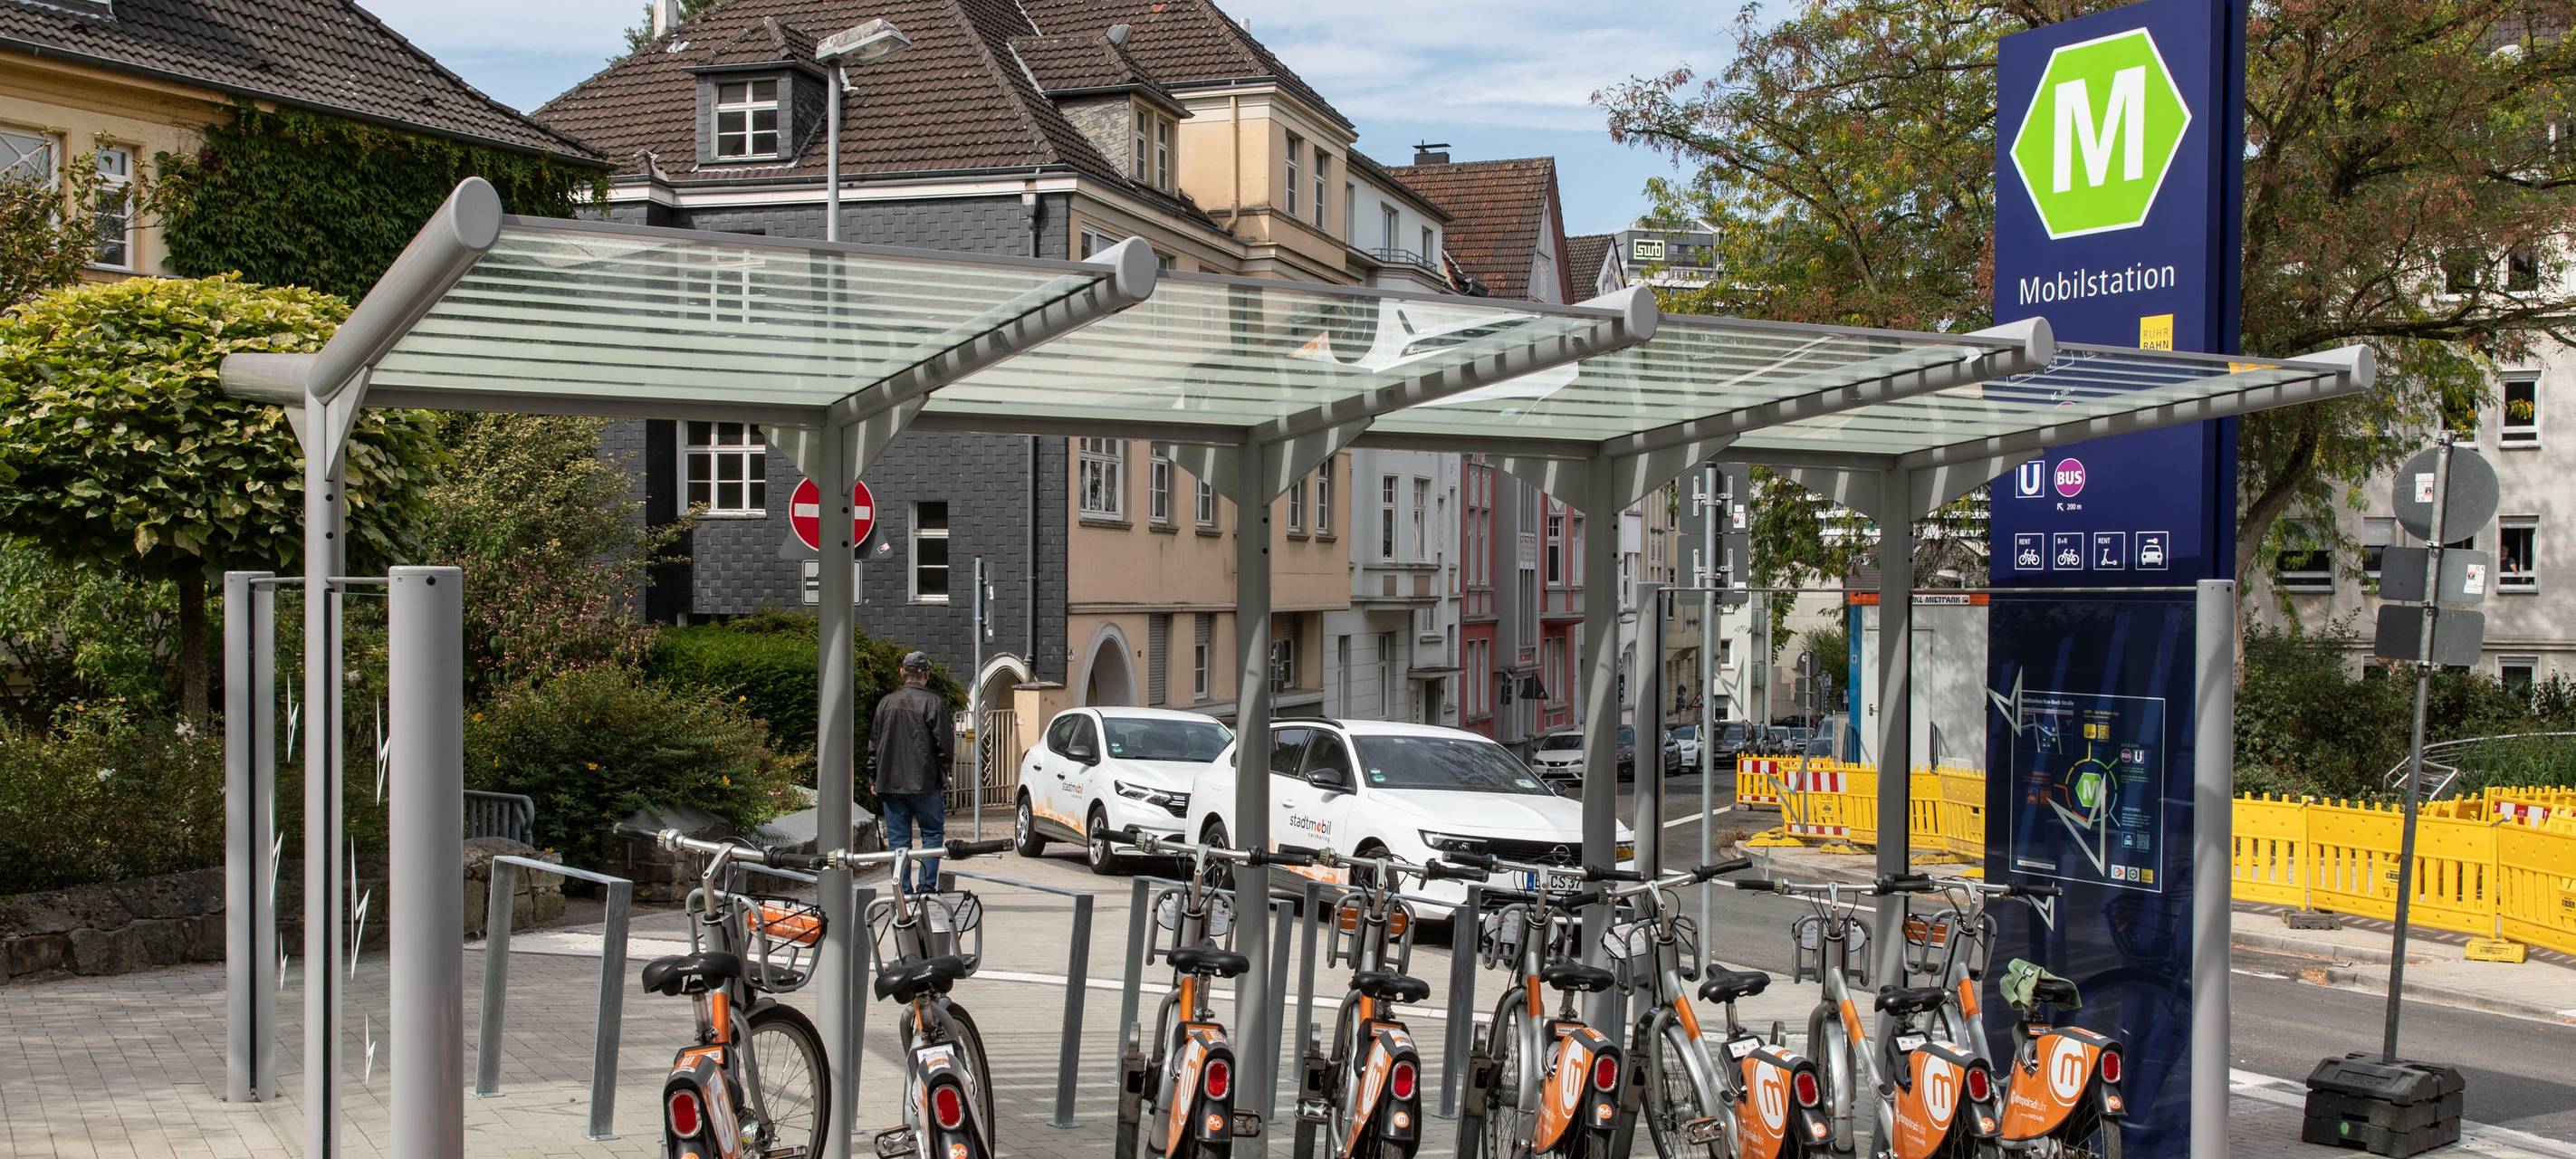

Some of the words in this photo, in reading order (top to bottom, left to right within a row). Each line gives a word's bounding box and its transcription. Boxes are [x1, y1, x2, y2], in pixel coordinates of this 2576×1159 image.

[2053, 65, 2146, 194] M
[2019, 262, 2175, 305] Mobilstation
[2143, 328, 2169, 340] RUHR
[2143, 340, 2169, 350] BAHN
[2020, 464, 2040, 495] U
[2056, 470, 2083, 485] BUS
[2066, 503, 2076, 511] 200
[2134, 751, 2142, 762] U
[2083, 779, 2100, 800] M
[1289, 814, 1332, 835] stadtmobil
[1550, 876, 1566, 889] CS
